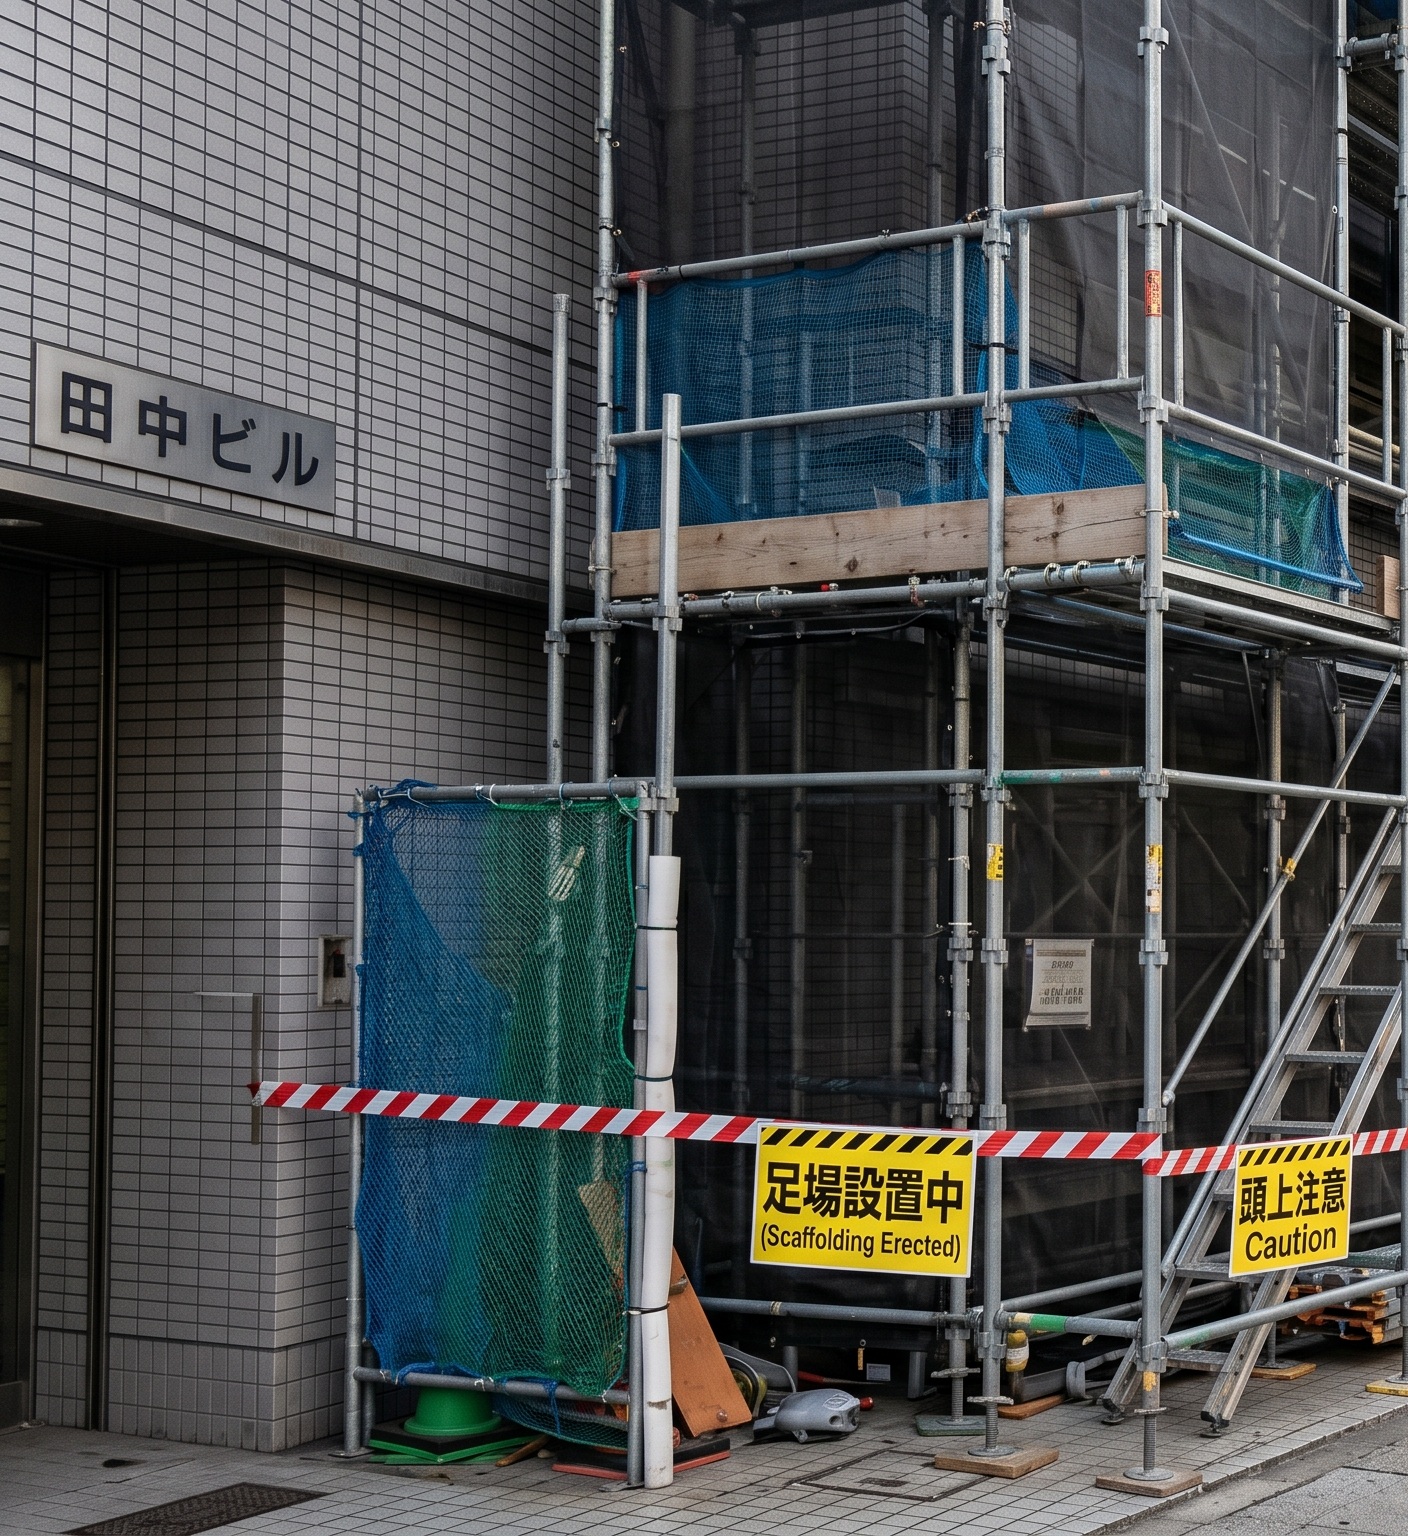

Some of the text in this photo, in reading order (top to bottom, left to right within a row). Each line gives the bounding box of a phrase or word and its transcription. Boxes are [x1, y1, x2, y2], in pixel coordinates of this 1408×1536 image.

[60, 370, 320, 487] 田中ビル
[762, 1161, 964, 1224] 足場設置中
[1238, 1166, 1347, 1226] 頭上注意
[761, 1222, 961, 1263] (Scaffolding Erected)
[1245, 1223, 1337, 1262] Caution
